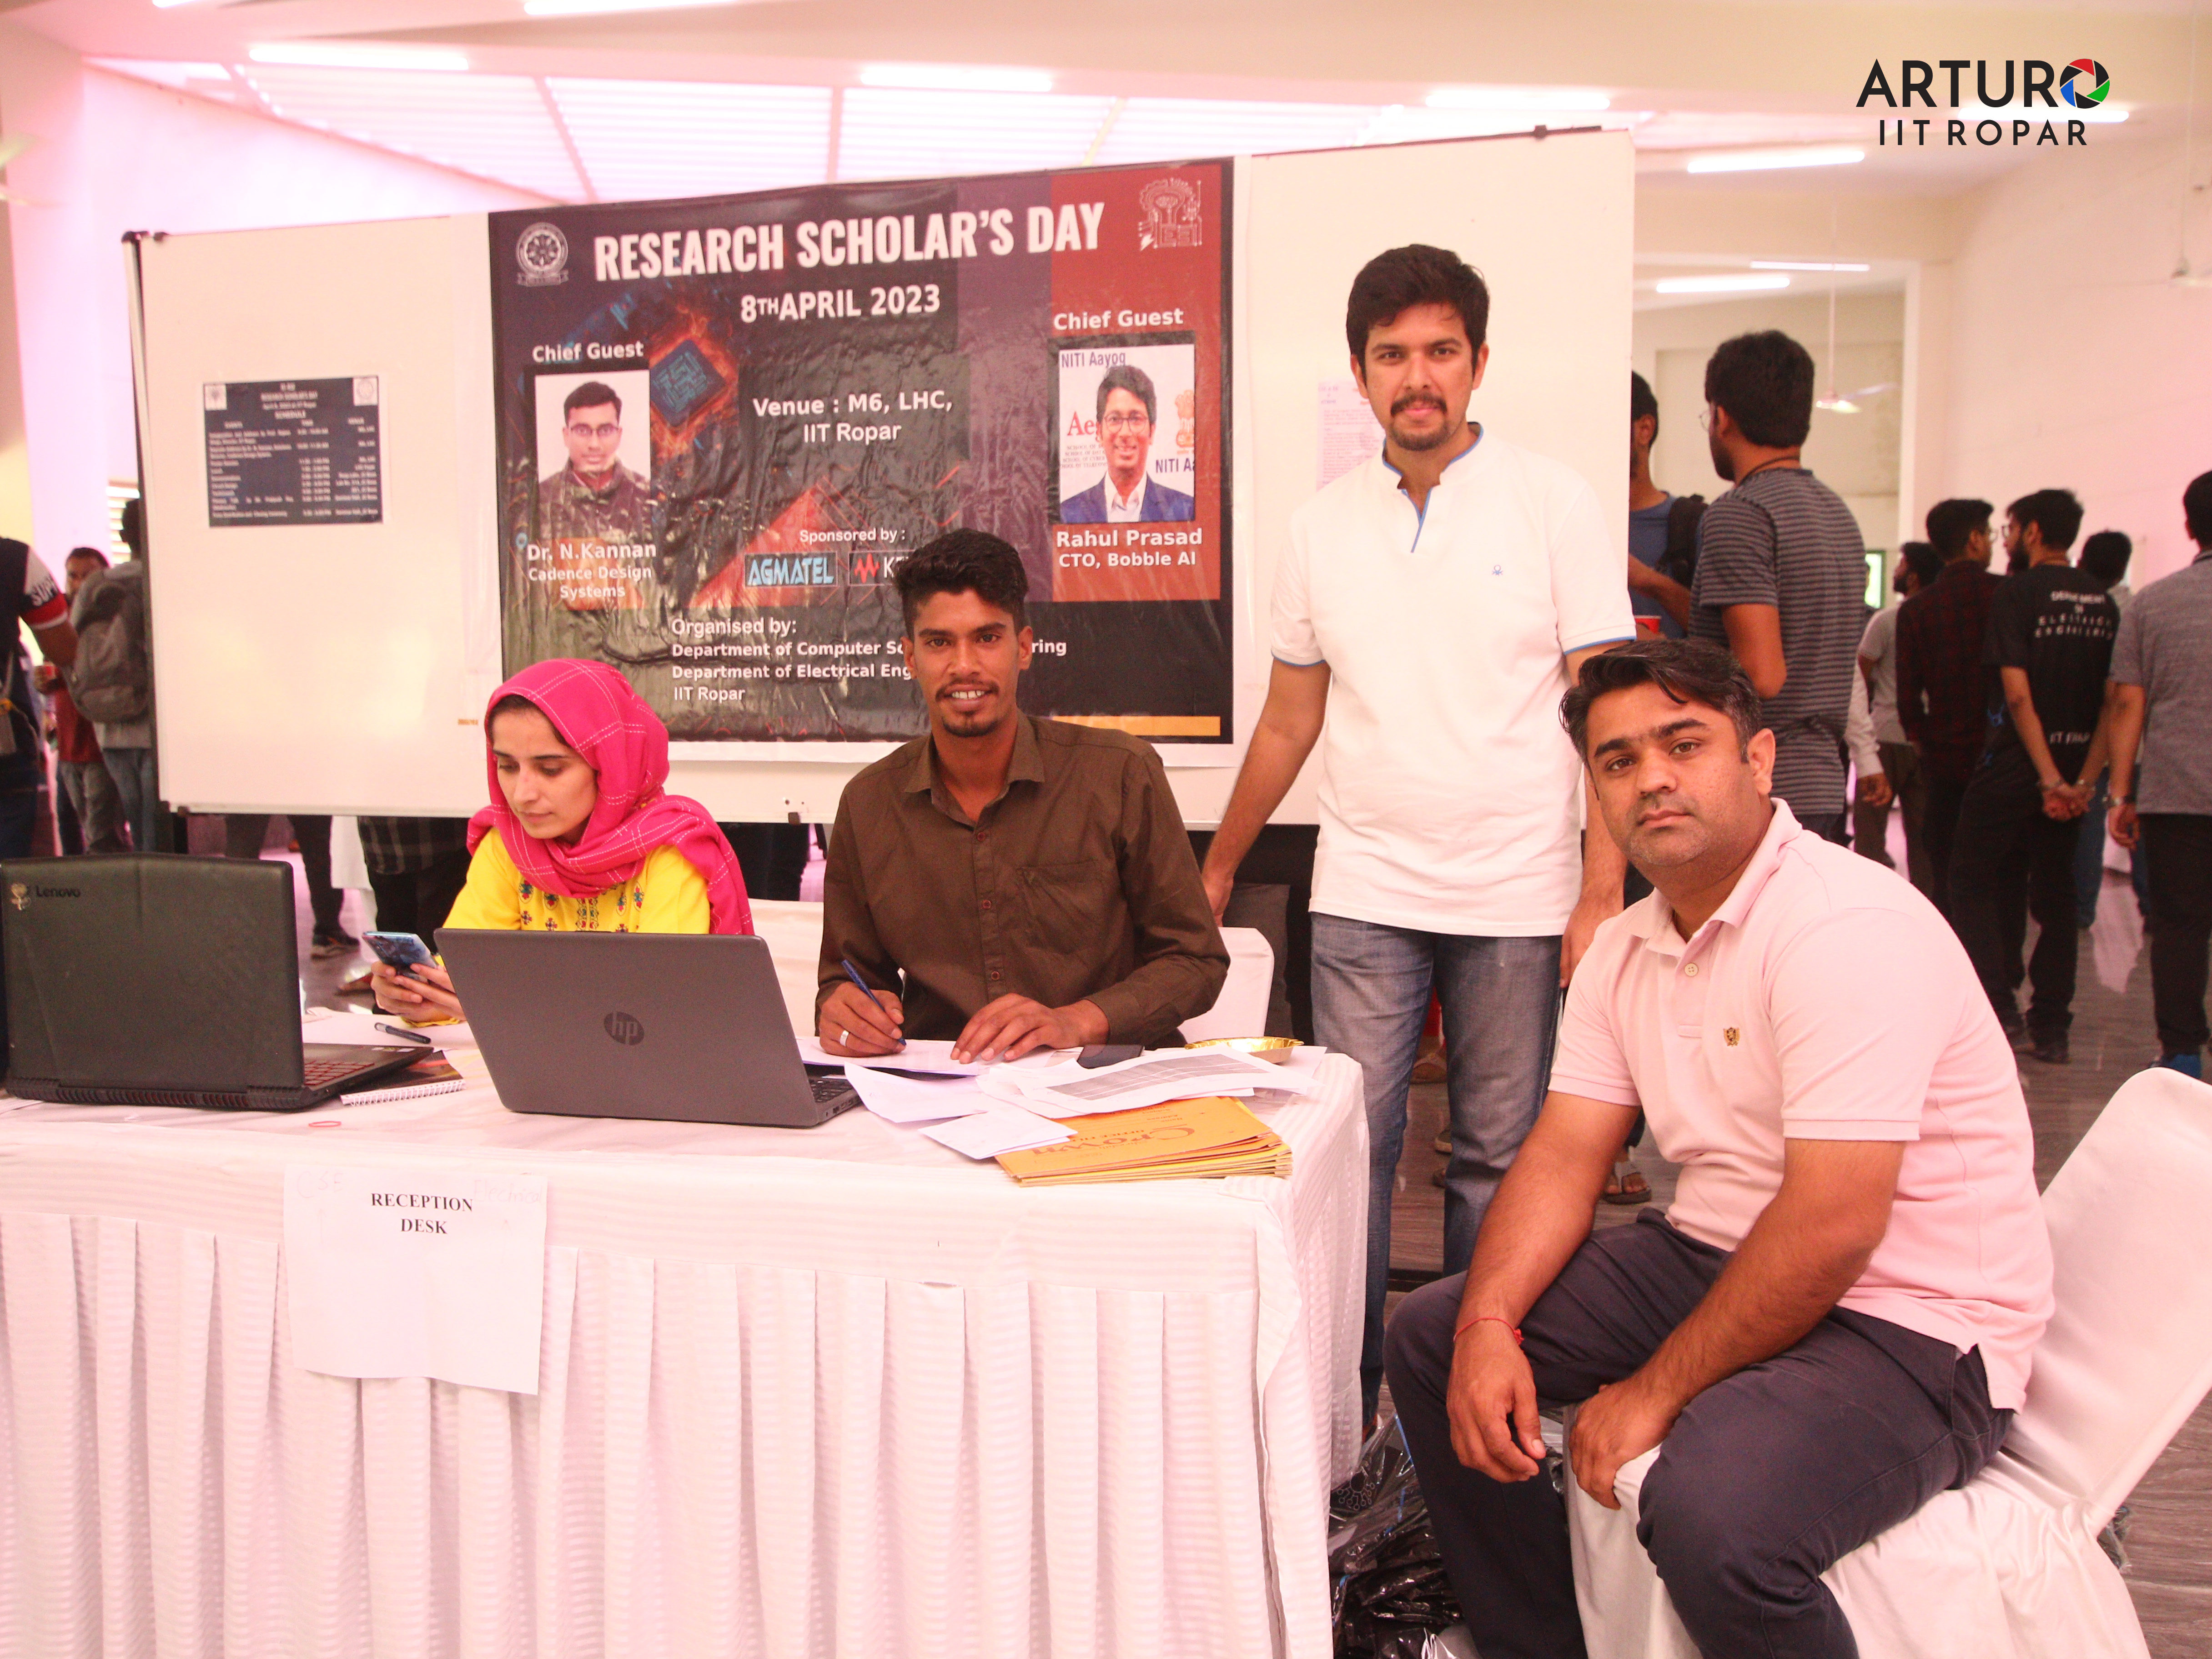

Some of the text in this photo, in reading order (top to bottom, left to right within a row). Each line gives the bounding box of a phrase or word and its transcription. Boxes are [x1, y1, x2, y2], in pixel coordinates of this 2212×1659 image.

[594, 224, 784, 281] RESEARCH
[797, 208, 1014, 268] SCHOLAR'S
[1027, 202, 1105, 253] DAY
[871, 284, 940, 316] 2023
[1054, 308, 1184, 331] Chief Guest
[533, 340, 644, 363] Chief Guest
[1062, 352, 1084, 367] NITI
[753, 398, 824, 417] Venue
[848, 393, 890, 414] M6,
[899, 390, 952, 412] LHC,
[804, 422, 901, 445] IIT Ropar
[1156, 458, 1179, 473] NITI
[799, 528, 876, 543] Sponsored
[881, 527, 898, 543] by
[1057, 527, 1203, 548] Rahul Prasad
[527, 544, 553, 561] Dr.
[1059, 551, 1196, 569] CTO, Bobble AI
[529, 565, 652, 582] Cadence Design
[747, 557, 835, 584] AGMATEL
[560, 585, 625, 601] Systems
[672, 617, 796, 638] Organised by:
[672, 643, 770, 659] Department
[775, 641, 793, 656] of
[797, 642, 881, 658] Computer
[672, 664, 770, 681] Department
[775, 664, 792, 679] of
[797, 663, 875, 678] Electrical
[674, 687, 745, 703] IIT Ropar
[36, 885, 81, 898] Lenovo
[607, 1011, 642, 1045] hp
[371, 1193, 473, 1212] RECEPTION
[401, 1218, 447, 1234] DESK
